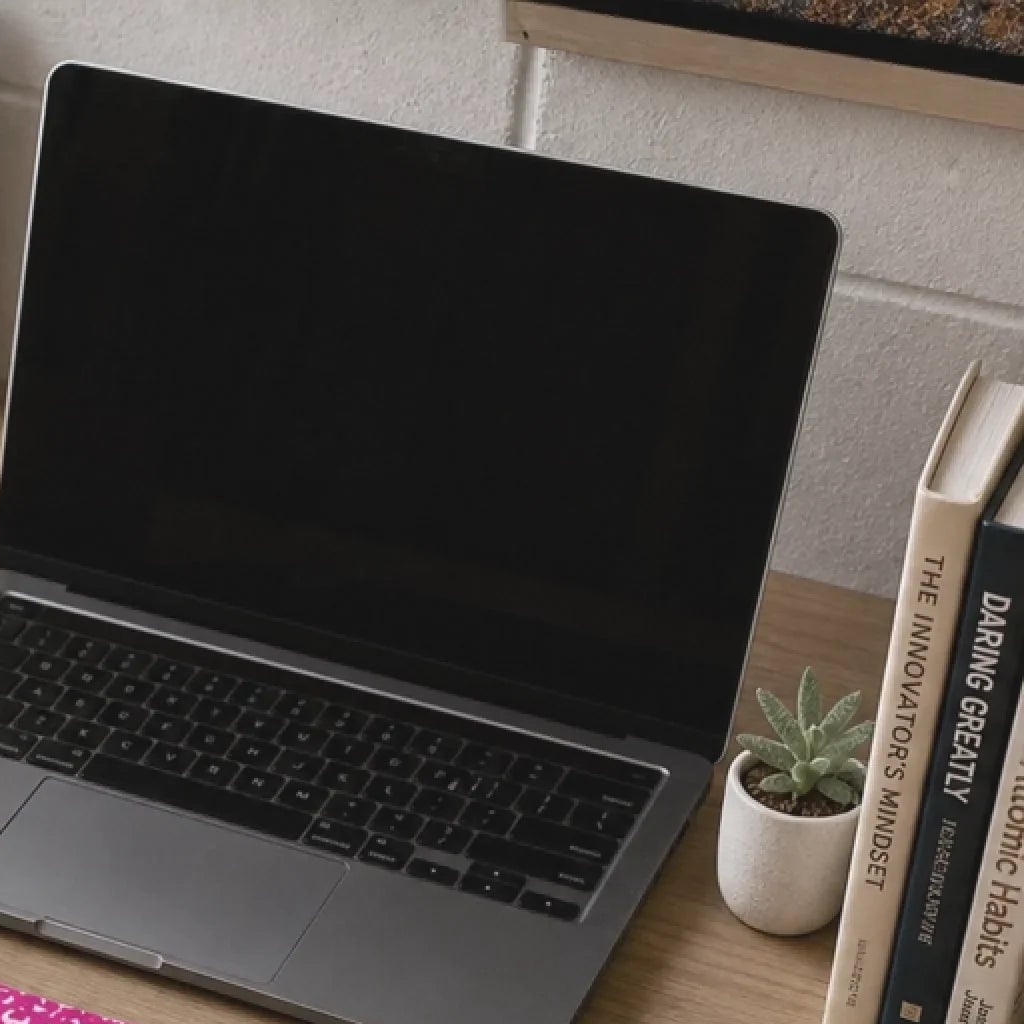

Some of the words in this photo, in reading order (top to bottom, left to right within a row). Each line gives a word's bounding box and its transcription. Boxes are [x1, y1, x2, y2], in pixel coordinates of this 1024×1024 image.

[917, 555, 945, 607] THE
[965, 591, 1012, 692] DARING
[883, 613, 934, 781] INNOVATOR'S
[943, 696, 989, 804] GREATLY
[865, 787, 902, 892] MINDSET
[975, 879, 1022, 969] Habits
